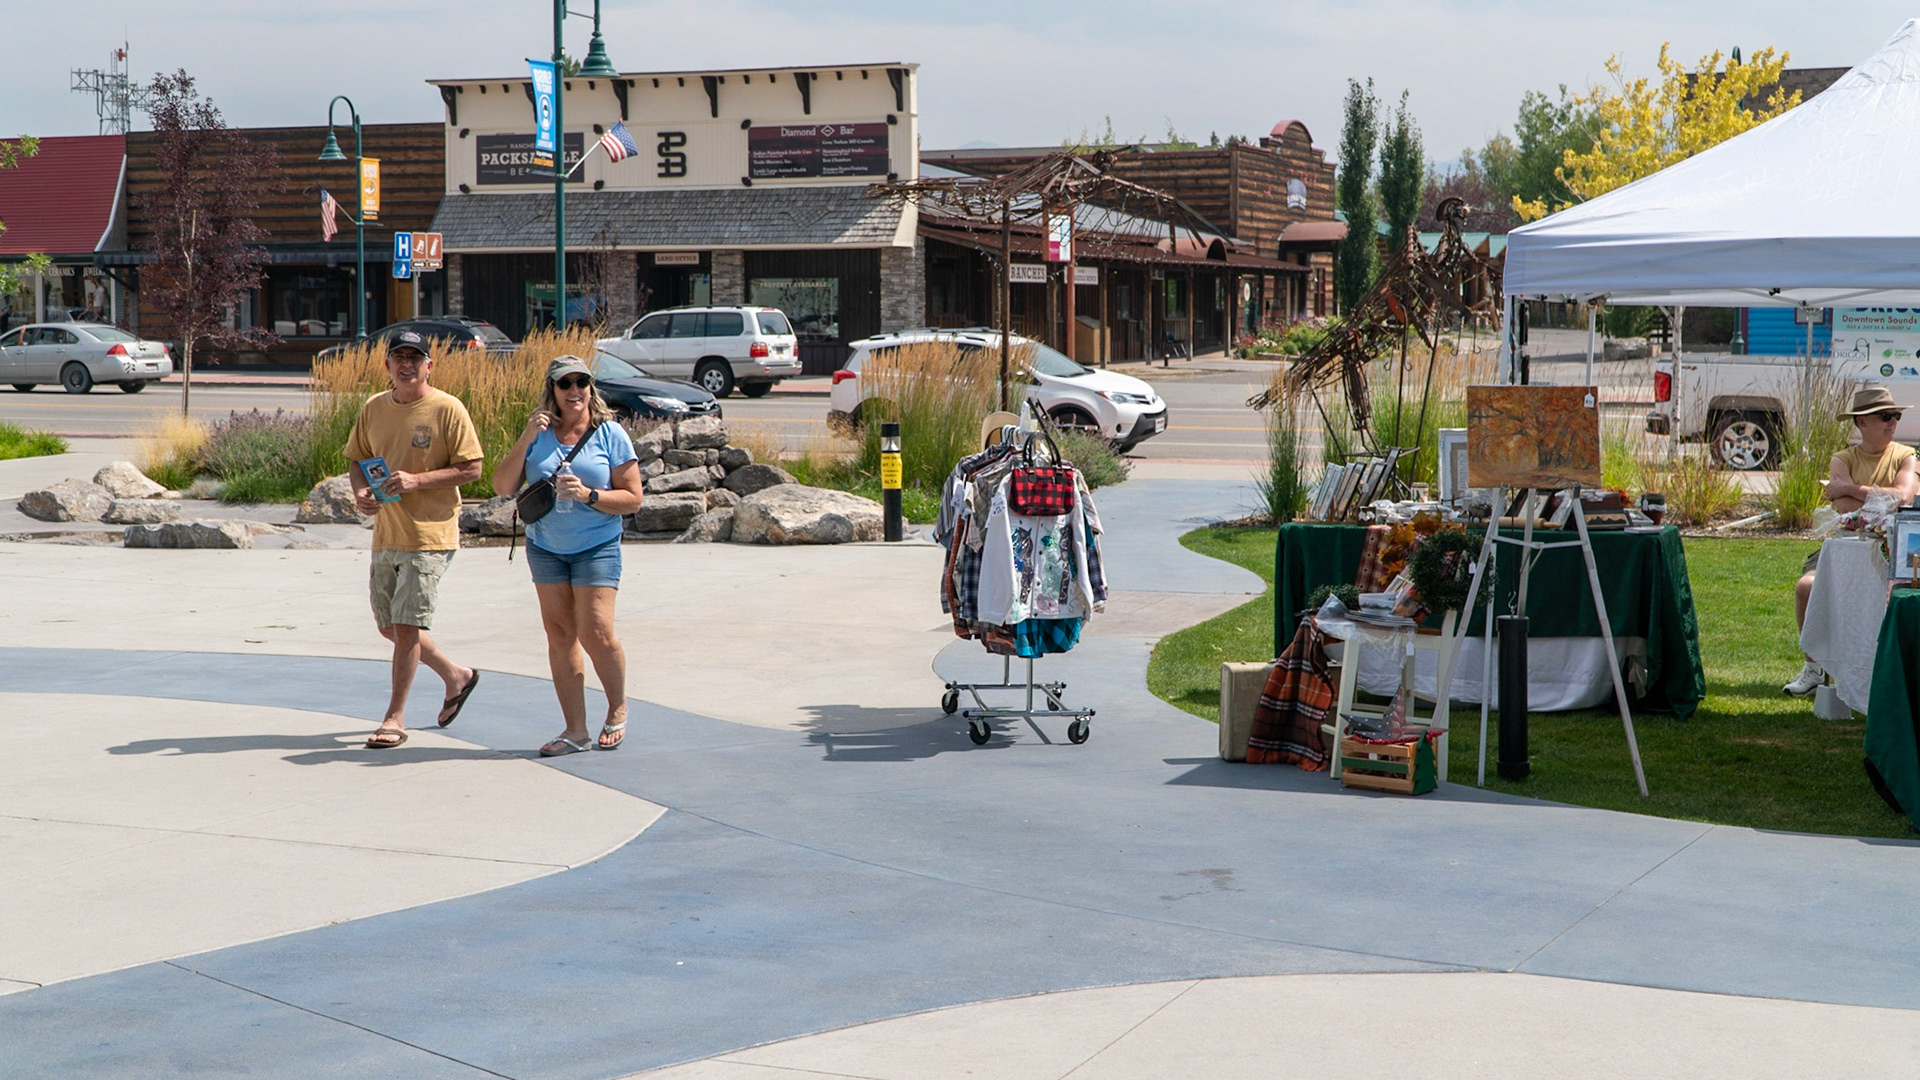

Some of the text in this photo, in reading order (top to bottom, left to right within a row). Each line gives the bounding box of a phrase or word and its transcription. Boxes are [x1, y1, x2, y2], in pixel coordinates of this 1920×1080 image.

[781, 126, 855, 137] Diamond Bar
[481, 151, 580, 165] PACKSLE
[398, 236, 409, 257] H
[1011, 267, 1045, 279] RANCHES
[1842, 315, 1918, 324] Downtown Sounds
[1832, 351, 1867, 359] DRIGGS
